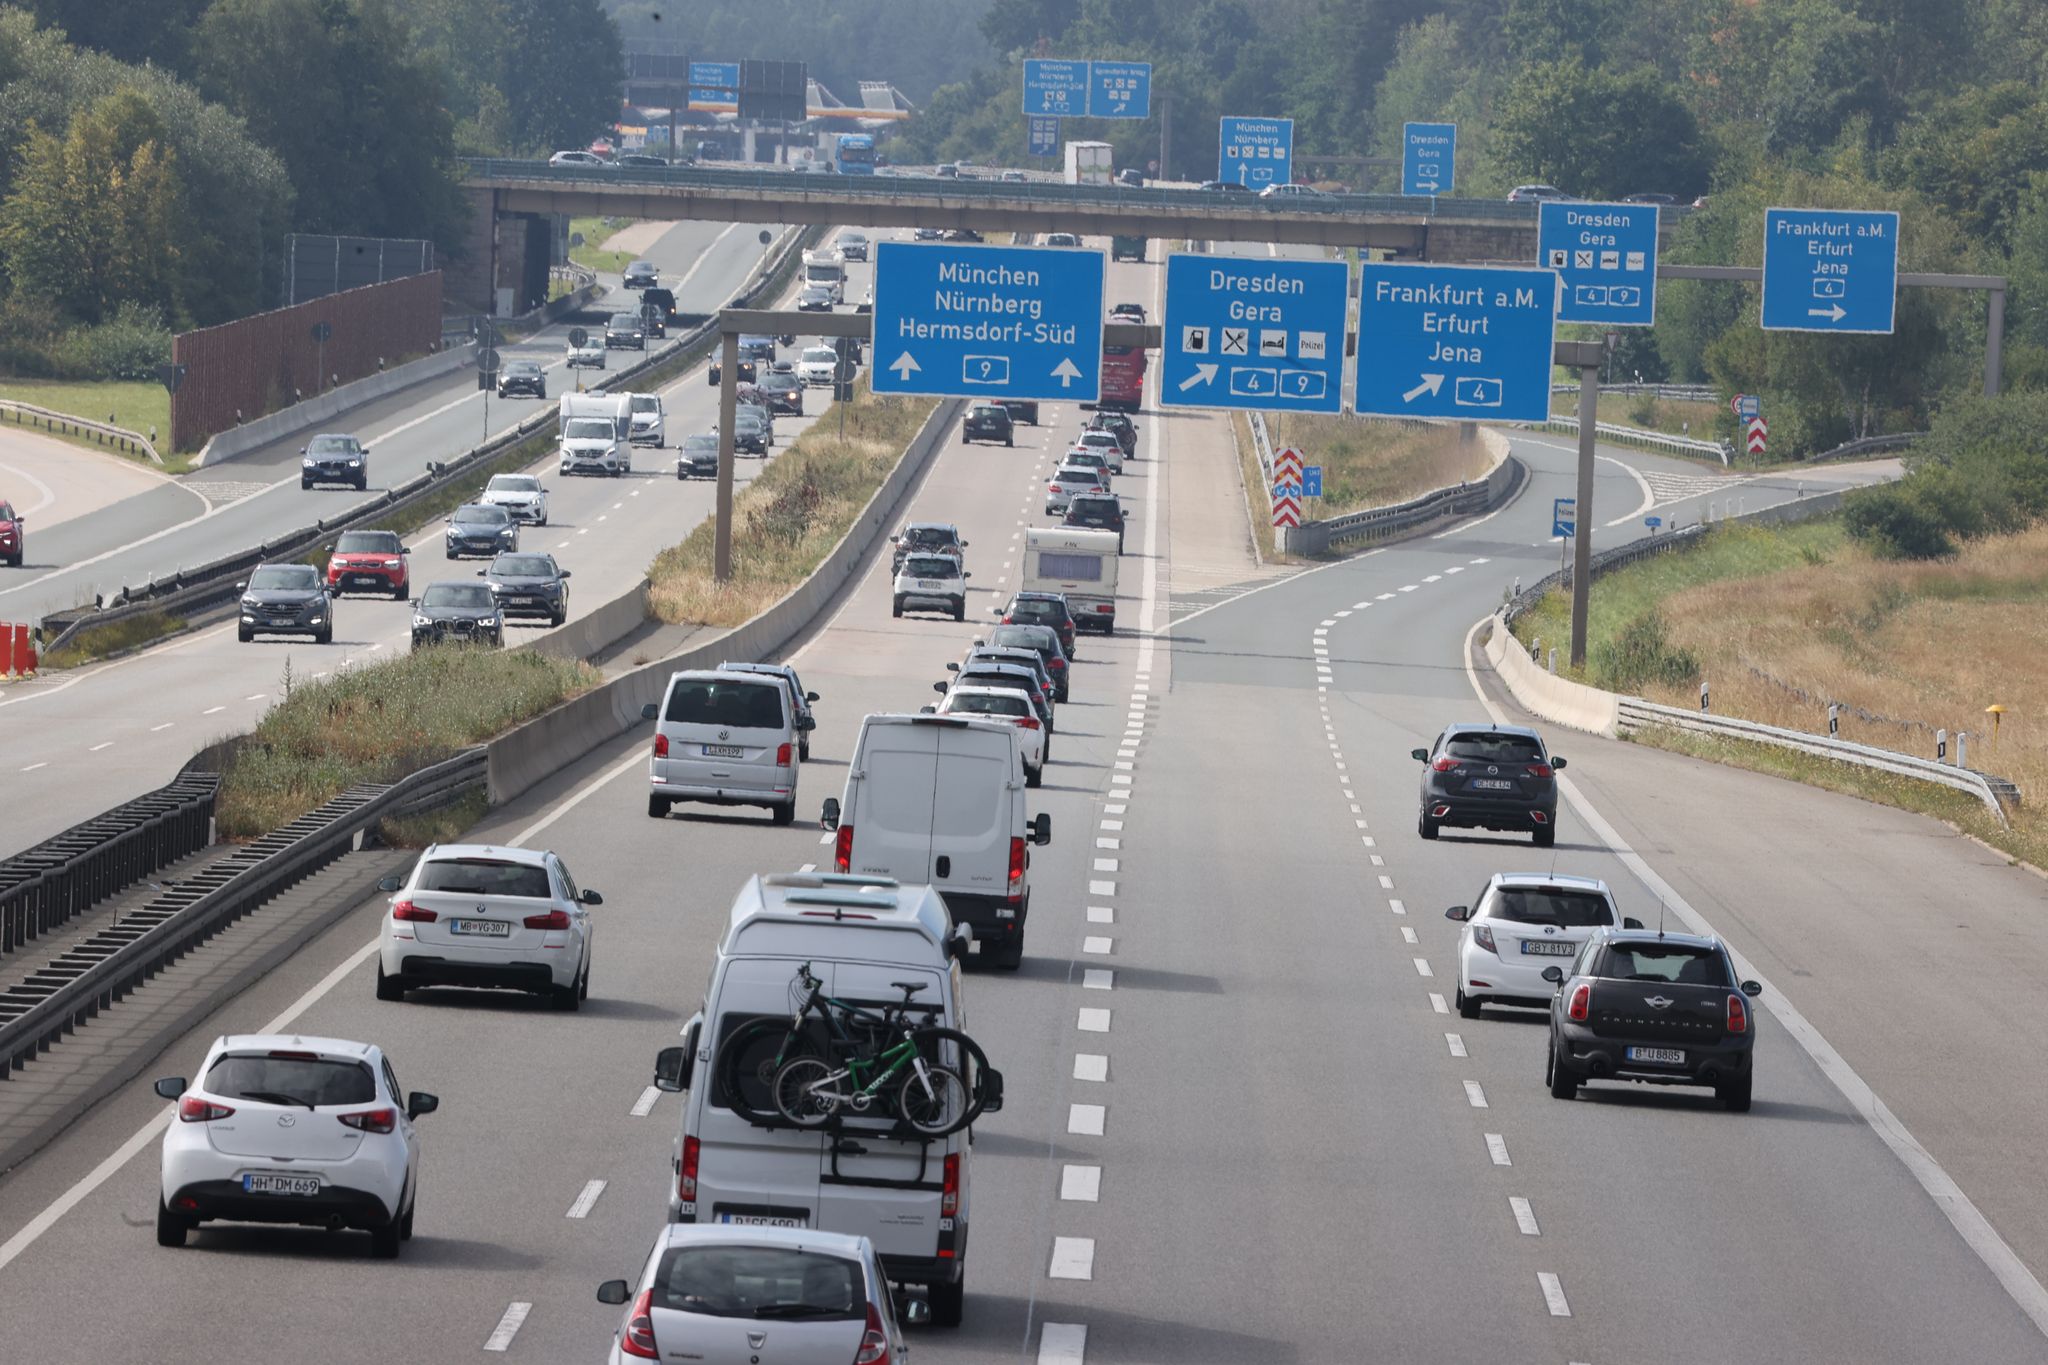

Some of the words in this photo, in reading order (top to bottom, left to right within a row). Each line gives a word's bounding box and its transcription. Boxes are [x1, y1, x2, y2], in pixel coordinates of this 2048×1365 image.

[1236, 123, 1278, 134] München
[1235, 134, 1279, 146] Nürnberg
[1410, 134, 1449, 145] Dresden
[1418, 148, 1440, 158] Gera
[1567, 211, 1631, 227] Dresden
[1777, 220, 1850, 236] Frankfurt
[1857, 223, 1886, 237] a.M.
[1580, 231, 1616, 246] Gera
[1808, 240, 1853, 256] Erfurt
[939, 262, 1039, 287] München
[1812, 260, 1848, 275] Jena
[1210, 270, 1304, 294] Dresden
[1824, 283, 1833, 293] 4
[1376, 281, 1484, 305] Frankfurt
[1495, 288, 1539, 308] a.M.
[1588, 289, 1595, 301] 4
[1620, 290, 1628, 302] 9
[935, 290, 1042, 320] Nürnberg
[1230, 300, 1282, 322] Gera
[900, 317, 1075, 345] Hermsdorf-Süd
[1423, 312, 1489, 335] Erfurt
[1301, 340, 1324, 351] Polizei
[1428, 341, 1482, 364] Jena
[980, 361, 991, 378] 9
[1247, 373, 1259, 390] 4
[1298, 376, 1309, 393] 9
[1473, 383, 1485, 400] 4
[460, 922, 472, 931] MB
[1527, 943, 1547, 952] GBY
[1635, 1049, 1642, 1058] B
[251, 1177, 268, 1189] HH
[275, 1179, 292, 1191] DM
